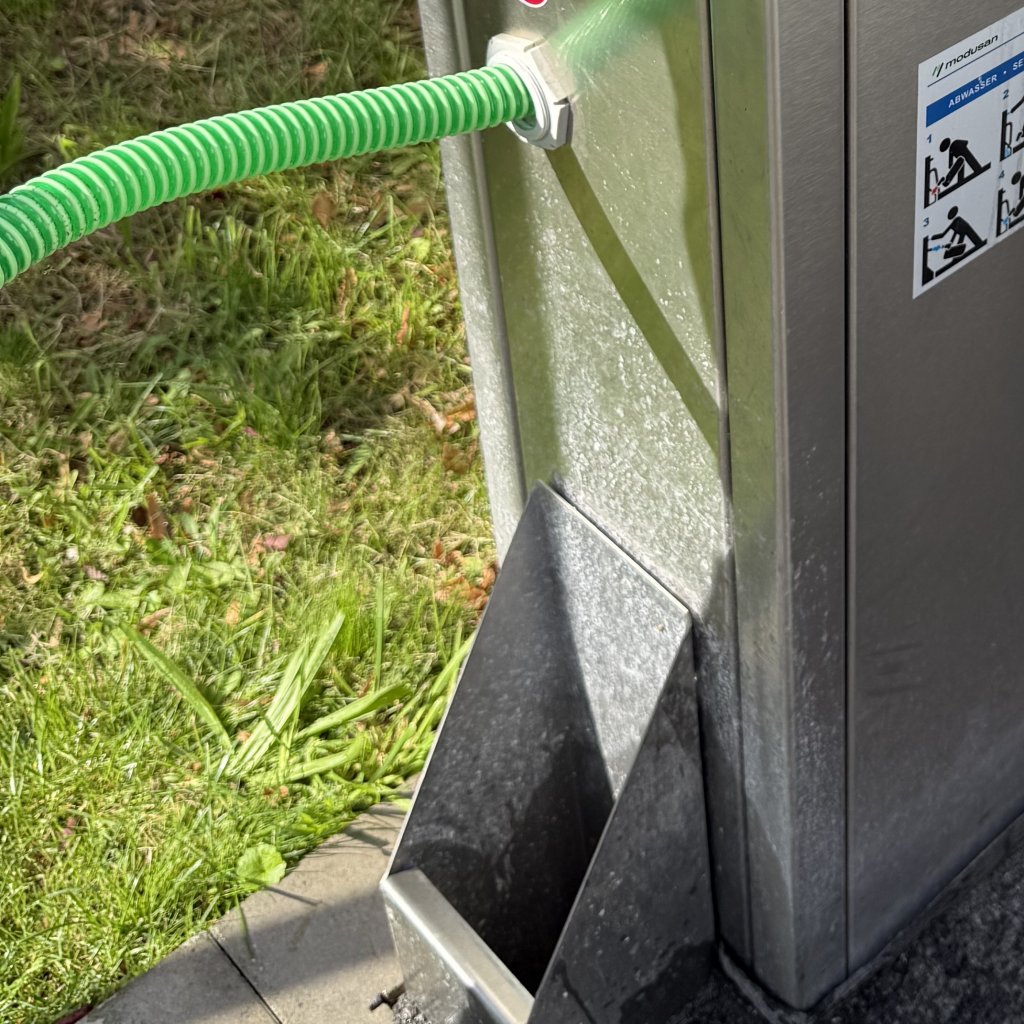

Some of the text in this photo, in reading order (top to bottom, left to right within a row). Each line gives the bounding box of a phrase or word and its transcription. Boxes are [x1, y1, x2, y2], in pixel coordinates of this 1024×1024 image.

[945, 34, 999, 69] modusan
[948, 74, 998, 108] ABWASSER
[1002, 88, 1010, 100] 2
[926, 133, 933, 144] 1
[923, 217, 930, 228] 3
